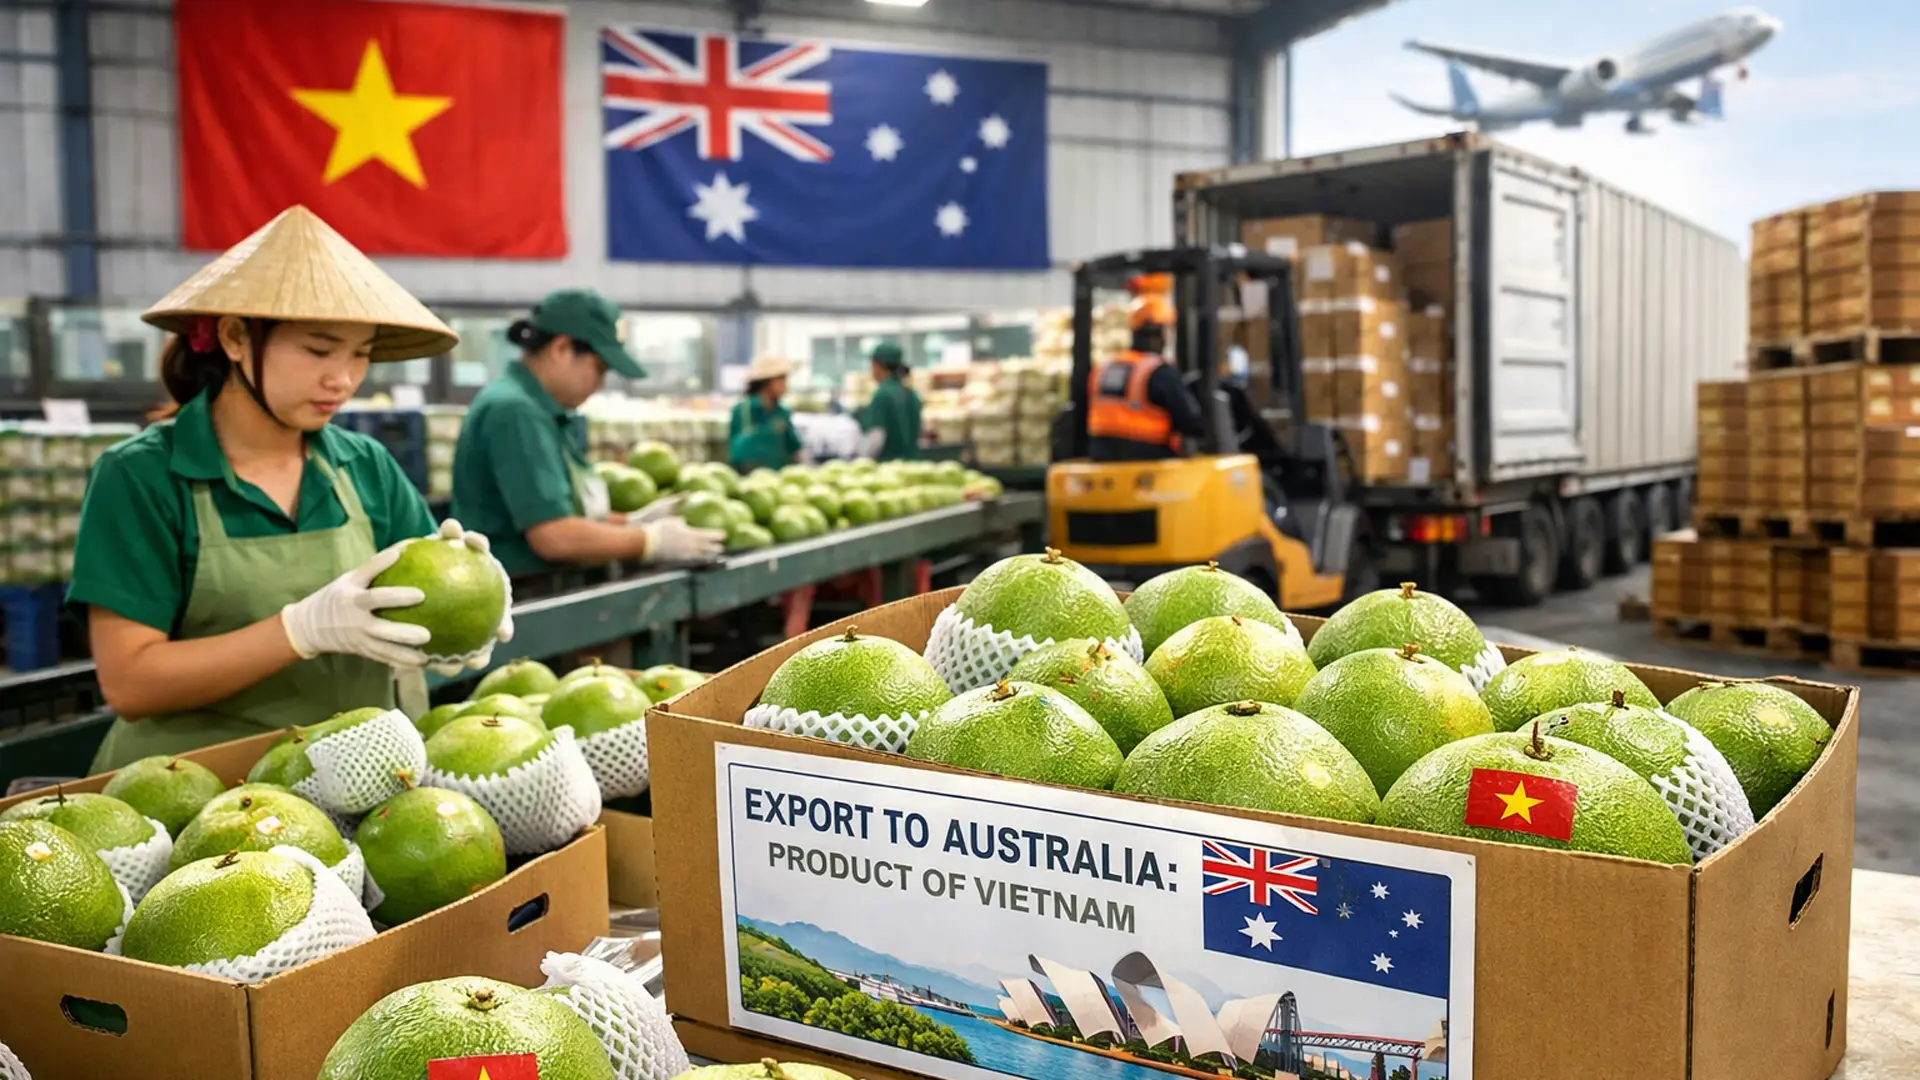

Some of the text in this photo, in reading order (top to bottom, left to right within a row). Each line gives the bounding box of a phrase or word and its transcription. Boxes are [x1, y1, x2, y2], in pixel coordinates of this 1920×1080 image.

[745, 787, 1177, 893] EXPORT TO AUSTRALIA:
[768, 841, 1135, 934] PRODUCT OF VIETNAM
